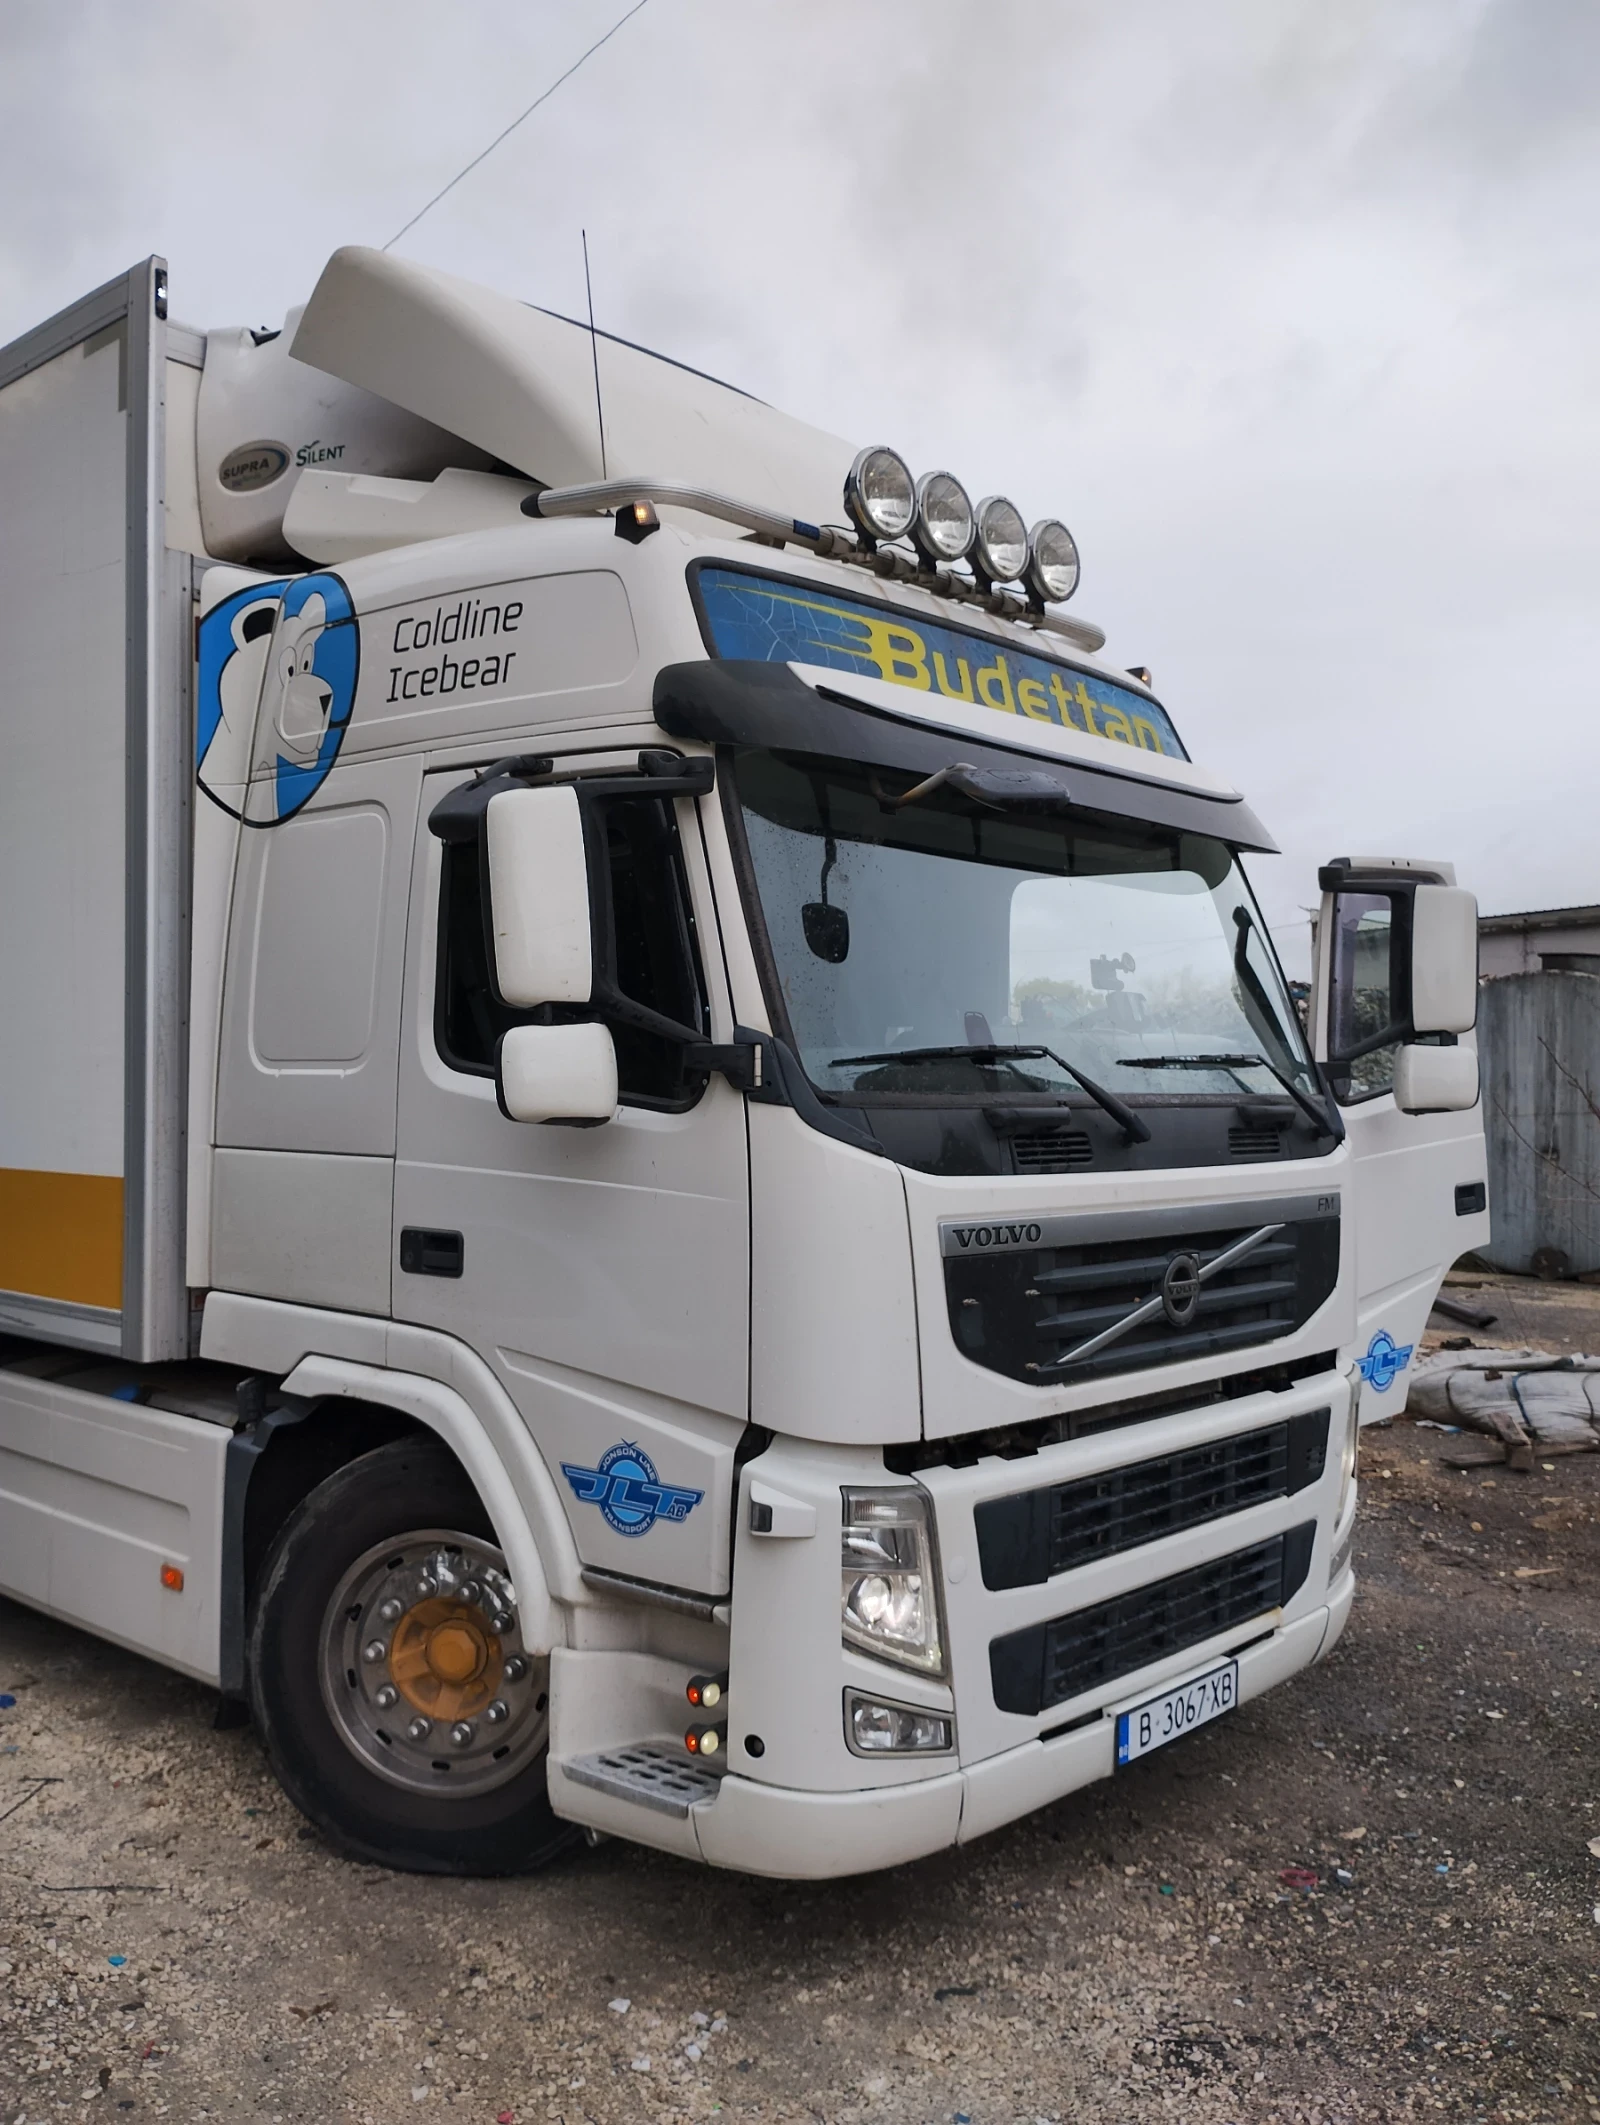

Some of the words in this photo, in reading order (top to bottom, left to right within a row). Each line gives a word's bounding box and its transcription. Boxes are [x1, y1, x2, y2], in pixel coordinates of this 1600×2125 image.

[223, 457, 270, 480] SUPRA
[393, 599, 524, 654] Coldline
[386, 652, 517, 703] Icebear
[866, 615, 1164, 755] Budettan
[1317, 1197, 1335, 1212] FM
[952, 1223, 1042, 1248] VOLVO
[602, 1447, 637, 1471] JONSON
[639, 1455, 656, 1480] LINE
[564, 1466, 698, 1517] JLT
[603, 1507, 652, 1533] TRANSPORT
